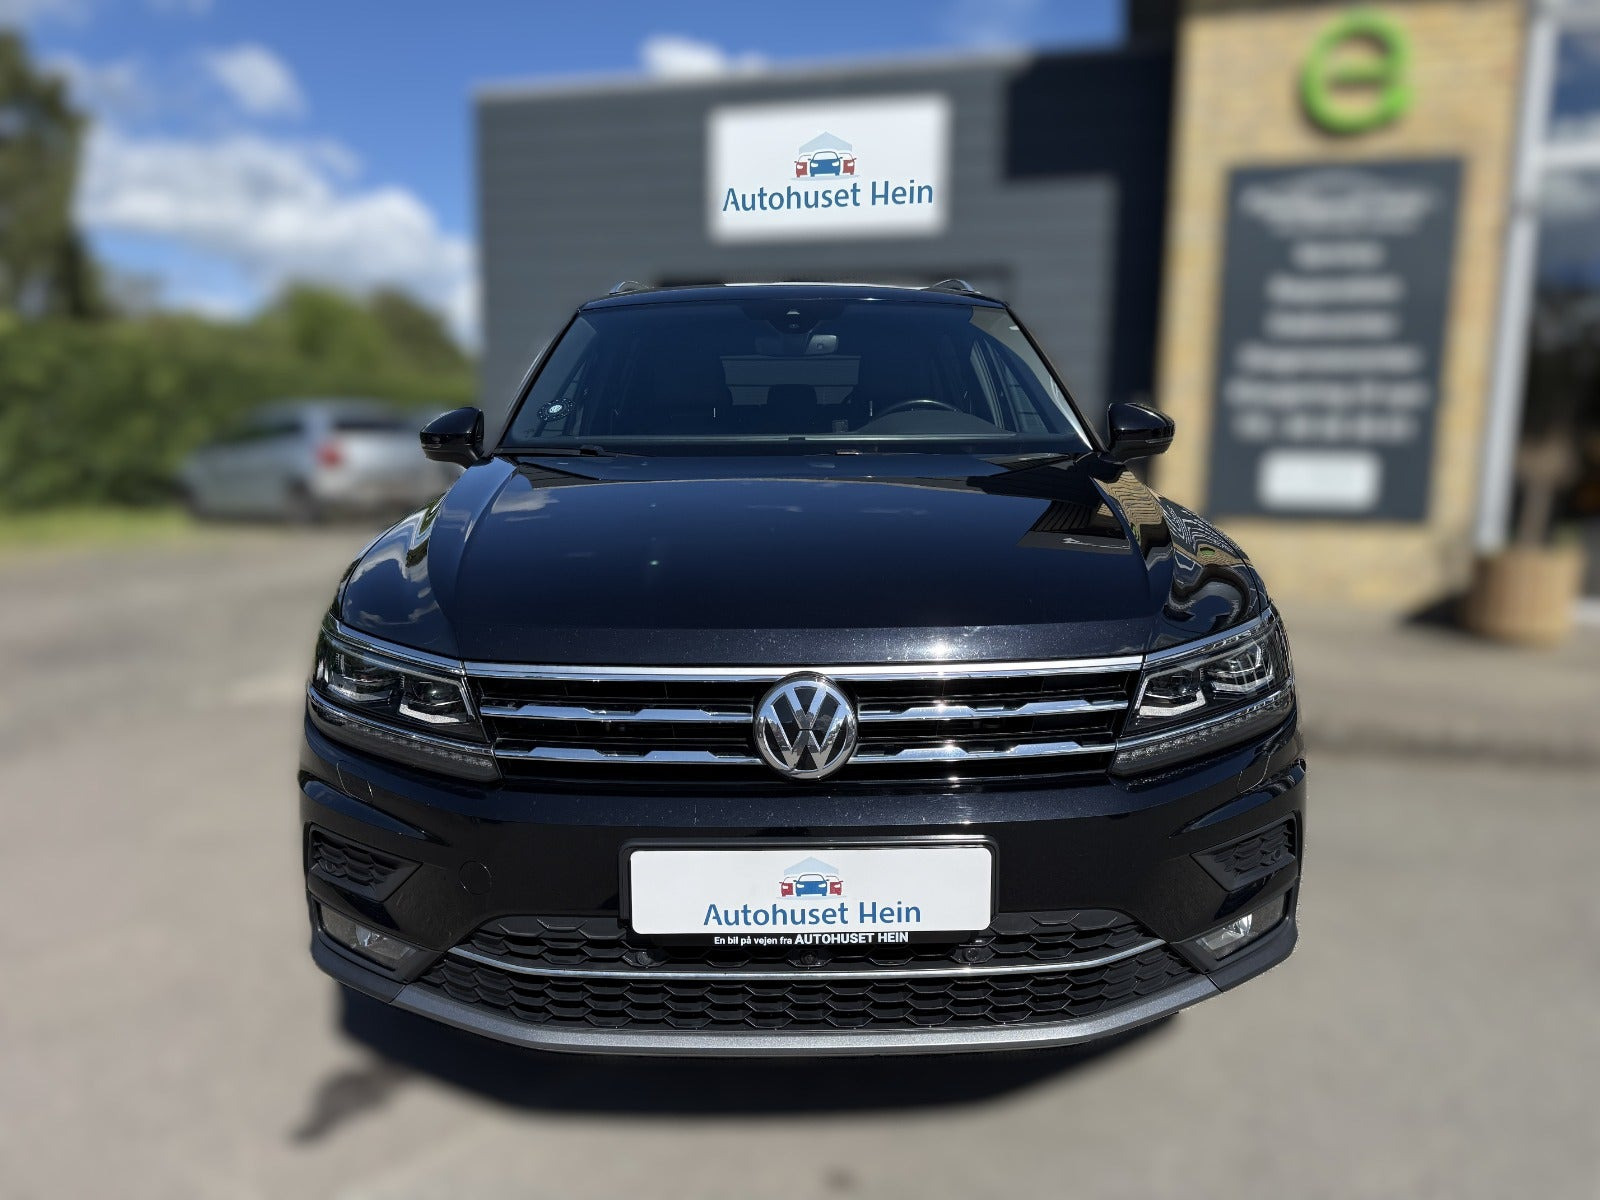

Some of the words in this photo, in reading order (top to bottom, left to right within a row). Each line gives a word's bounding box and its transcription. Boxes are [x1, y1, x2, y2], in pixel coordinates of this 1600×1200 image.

[722, 182, 861, 212] Autohuset
[871, 179, 933, 206] Hein
[703, 903, 849, 927] Autohuset
[859, 901, 921, 924] Hein
[713, 936, 726, 945] En
[727, 935, 739, 945] bil
[740, 934, 752, 946] på
[753, 936, 778, 946] vejen
[779, 936, 793, 945] fra
[794, 932, 875, 945] AUTOHUSET
[877, 931, 909, 943] HEIN
